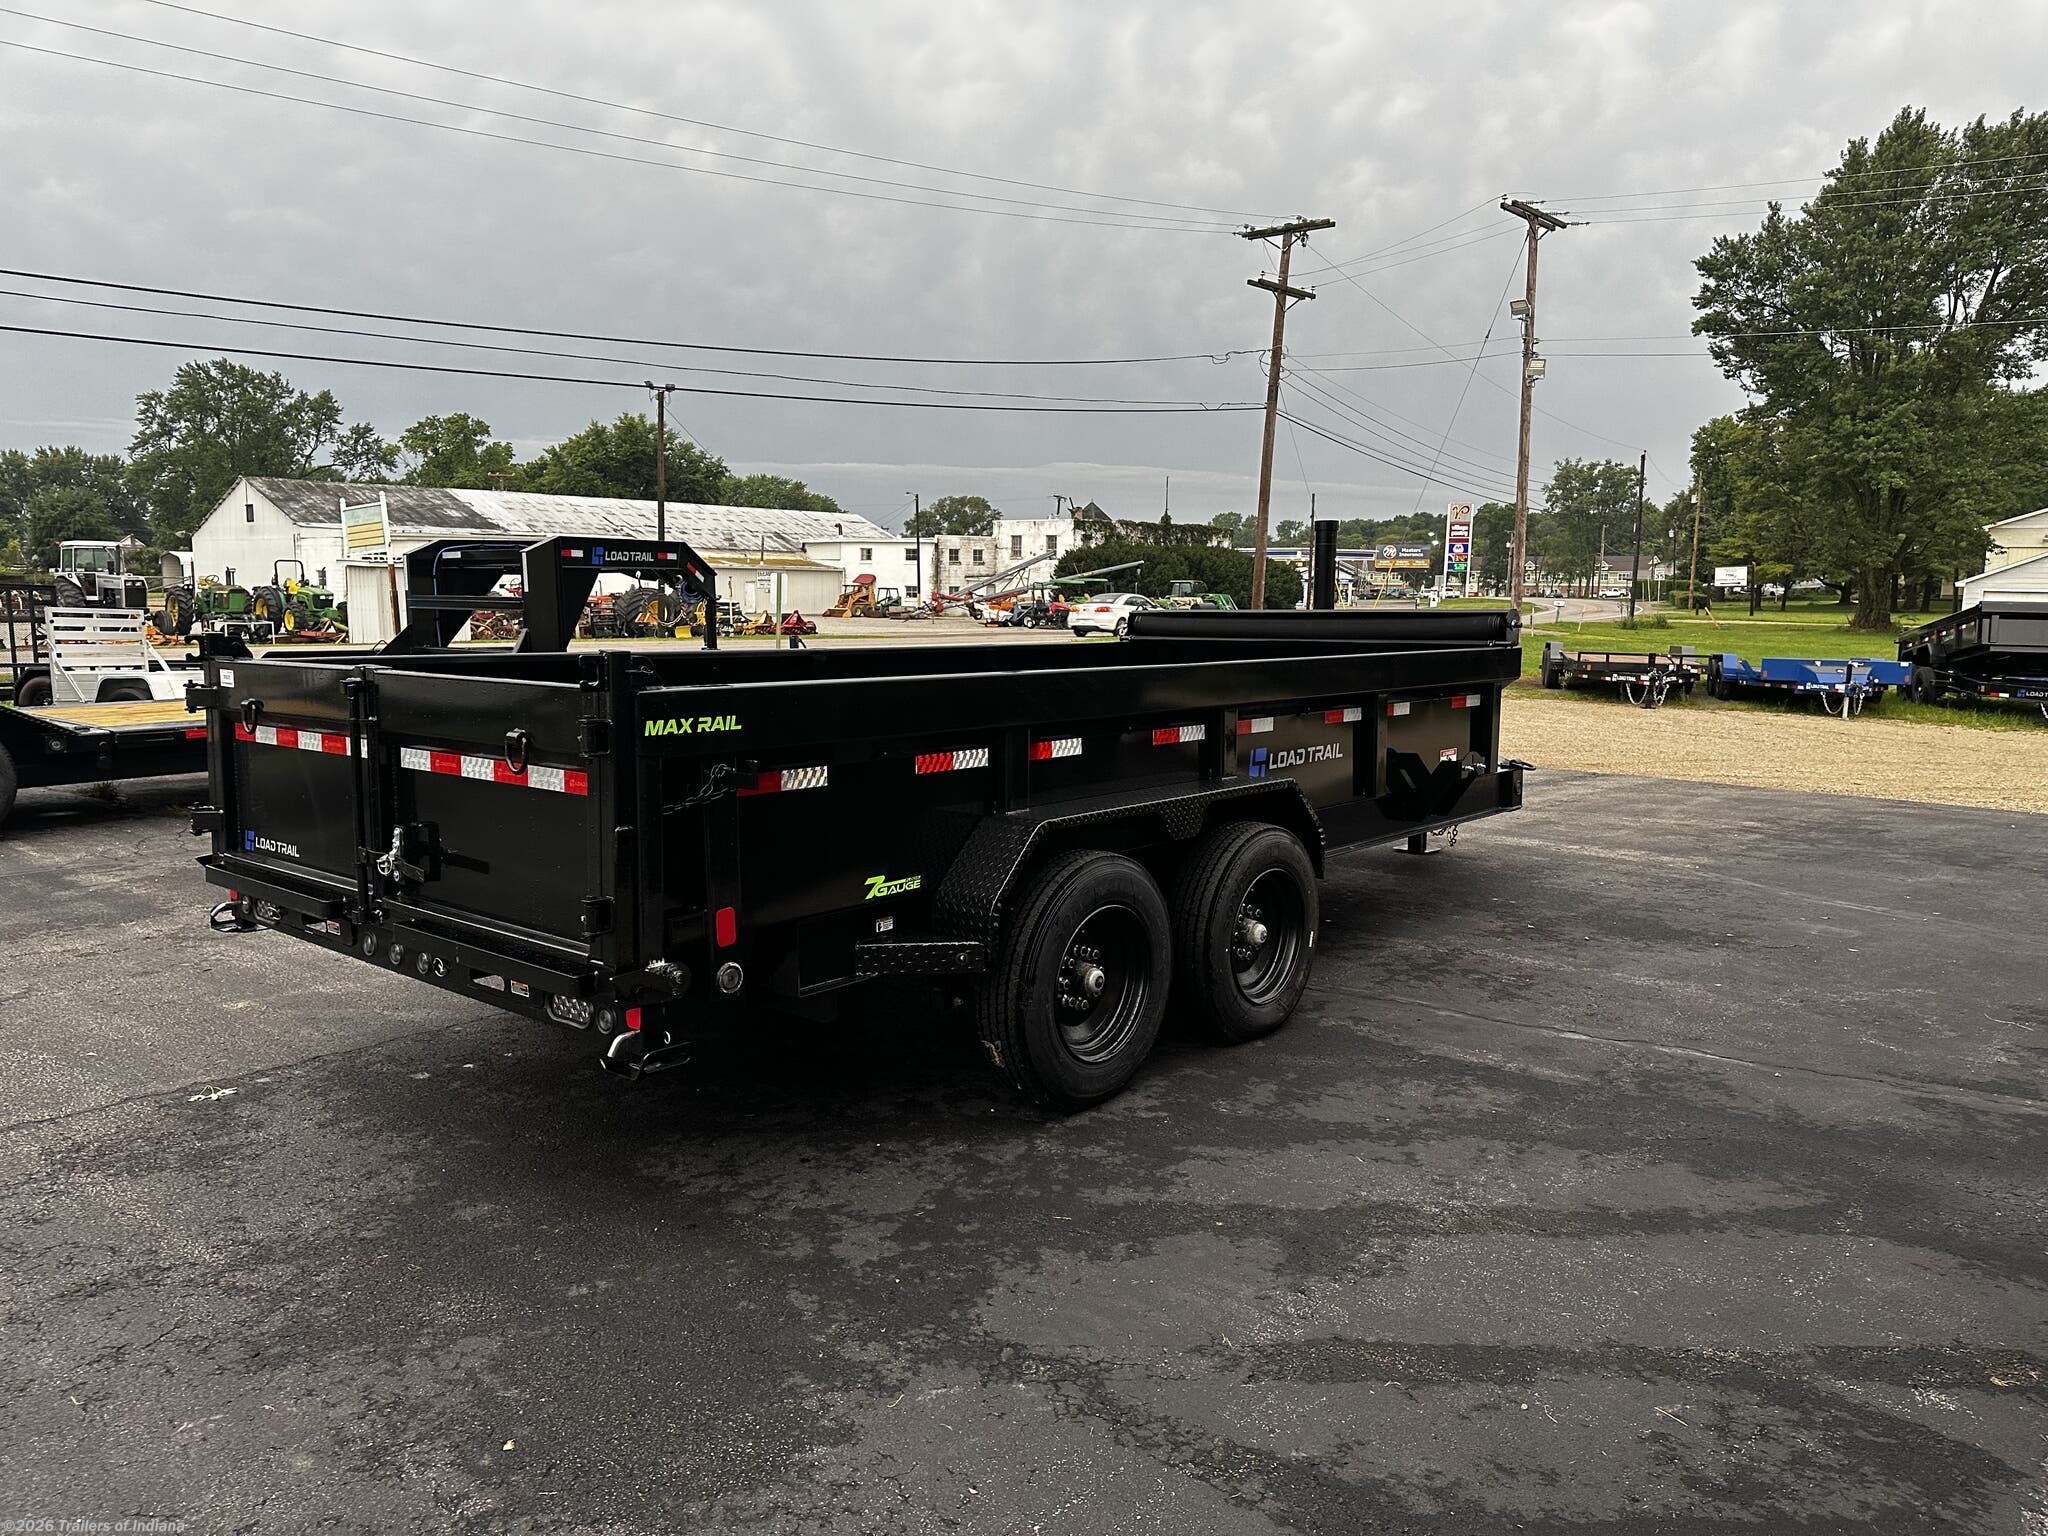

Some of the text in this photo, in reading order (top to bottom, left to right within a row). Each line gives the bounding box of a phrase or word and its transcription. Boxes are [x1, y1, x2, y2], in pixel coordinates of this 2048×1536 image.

[605, 551, 654, 562] LOAD TRAIL
[644, 715, 742, 737] MAX RAIL
[1268, 742, 1343, 770] LOAD TRAIL
[255, 836, 300, 858] LOAD TRAIL
[864, 875, 921, 900] 7 GAUGE
